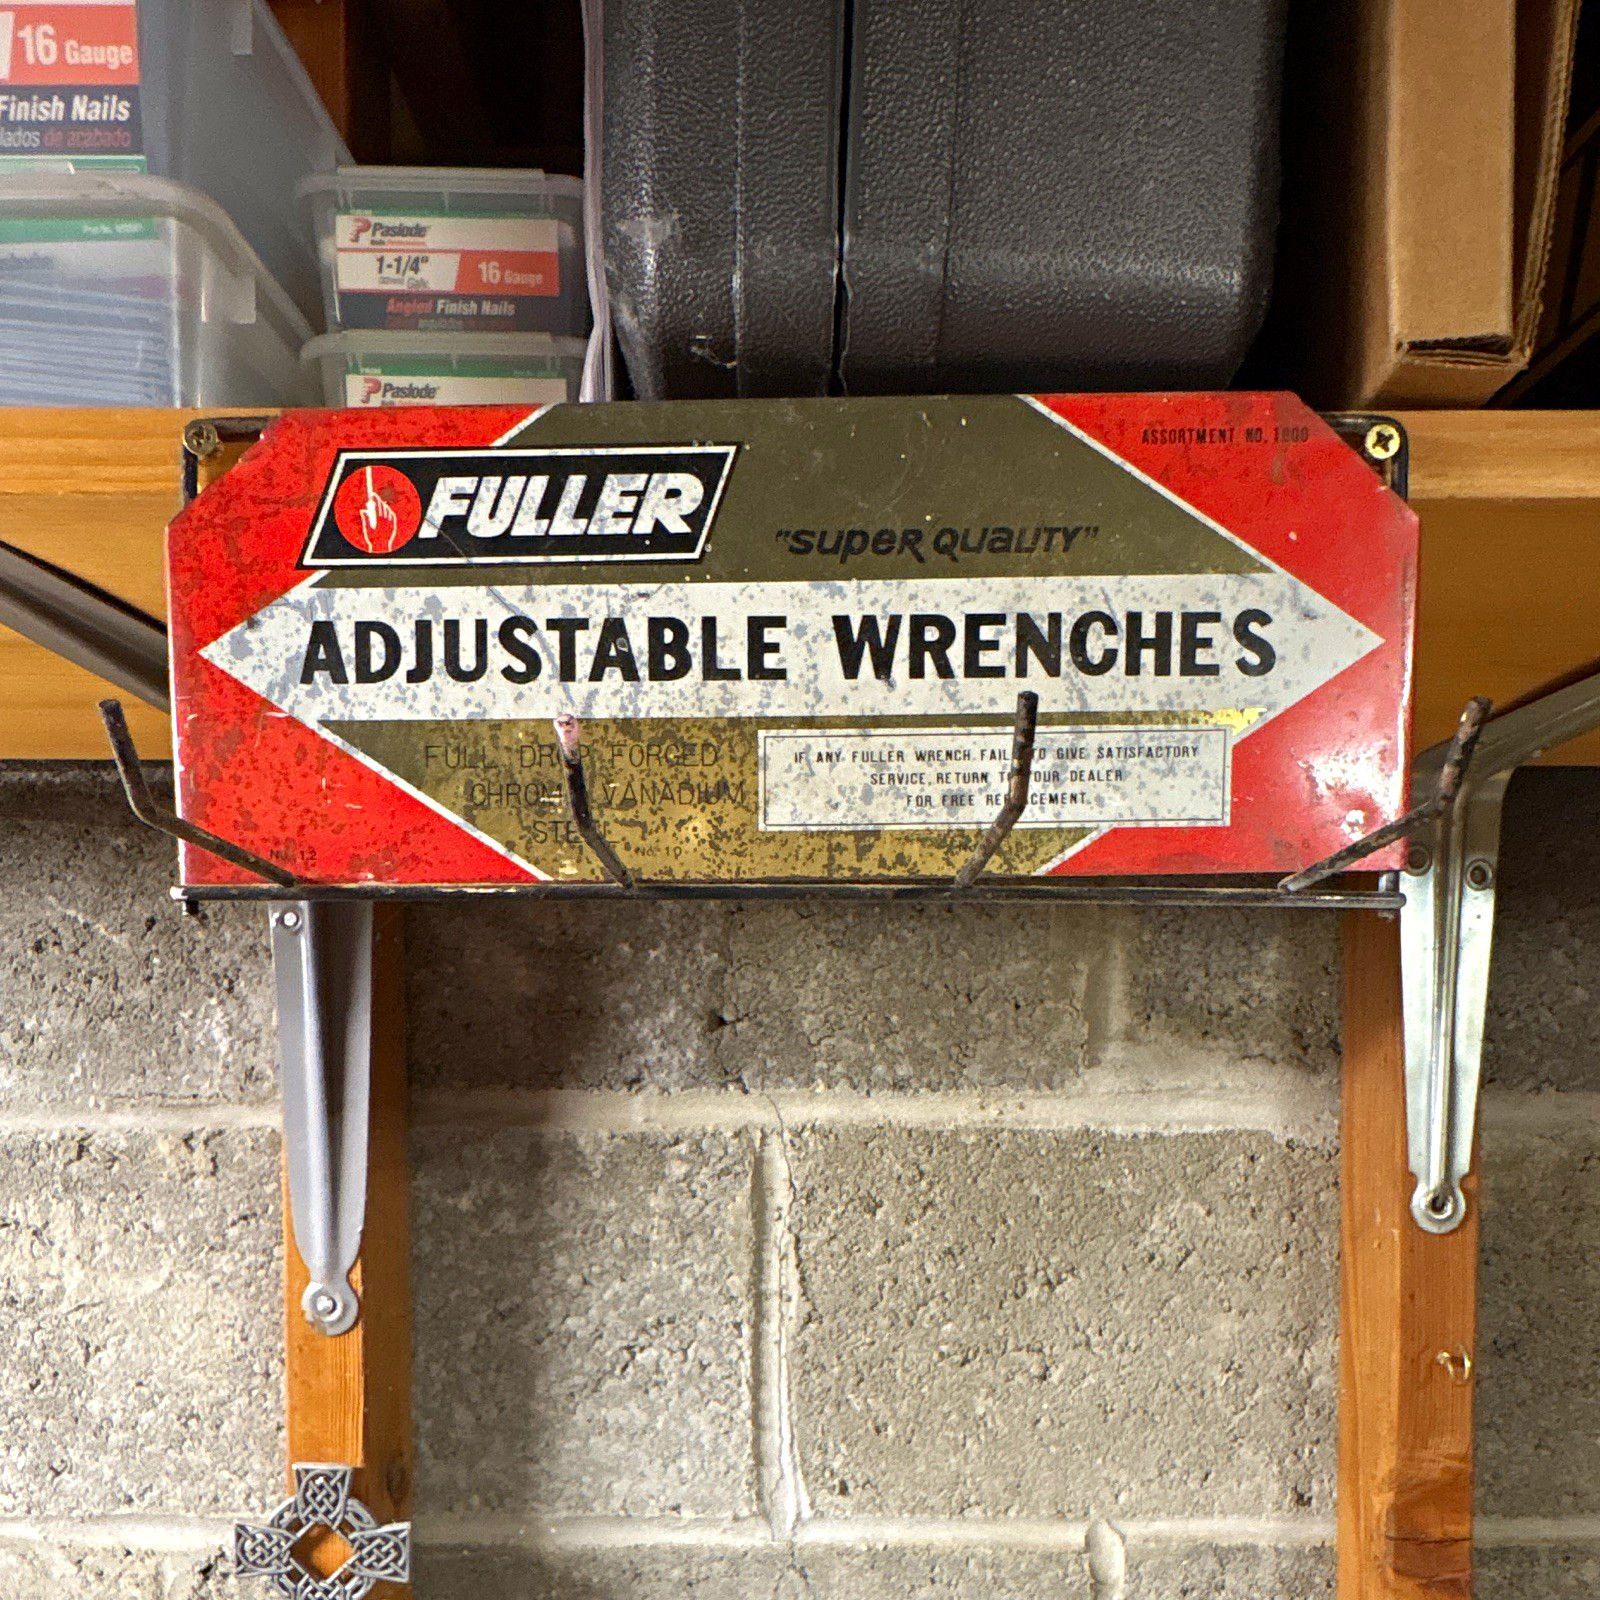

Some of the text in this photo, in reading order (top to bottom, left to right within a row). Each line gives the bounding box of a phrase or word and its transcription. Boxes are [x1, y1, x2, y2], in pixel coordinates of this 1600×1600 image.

[17, 24, 133, 70] 16 Gauge
[0, 94, 131, 122] Finish Nails
[371, 222, 427, 238] Paslode
[478, 261, 543, 288] 16 Gauge
[436, 300, 478, 315] Finish
[481, 301, 516, 316] Nails
[382, 382, 437, 399] Paslode
[1141, 427, 1235, 445] ASSORTMENT
[1245, 427, 1269, 443] NO.
[418, 472, 705, 539] FULLER
[299, 608, 1277, 685] ADJUSTABLE WRENCHES
[425, 745, 498, 770] FULL
[610, 743, 719, 768] FORGED
[794, 751, 806, 763] IF
[816, 750, 842, 763] ANY
[852, 749, 905, 763] FULLER
[915, 748, 970, 762] WRENCH
[980, 748, 1010, 761] FAIL
[1056, 747, 1086, 760] GIVE
[1097, 746, 1199, 760] SATISFACTORY
[936, 771, 989, 784] RETURN
[1031, 770, 1060, 783] OUR
[1070, 769, 1122, 782] DEALER
[602, 780, 747, 806] VANADIUM
[906, 794, 932, 807] FOR
[941, 793, 975, 807] FREE
